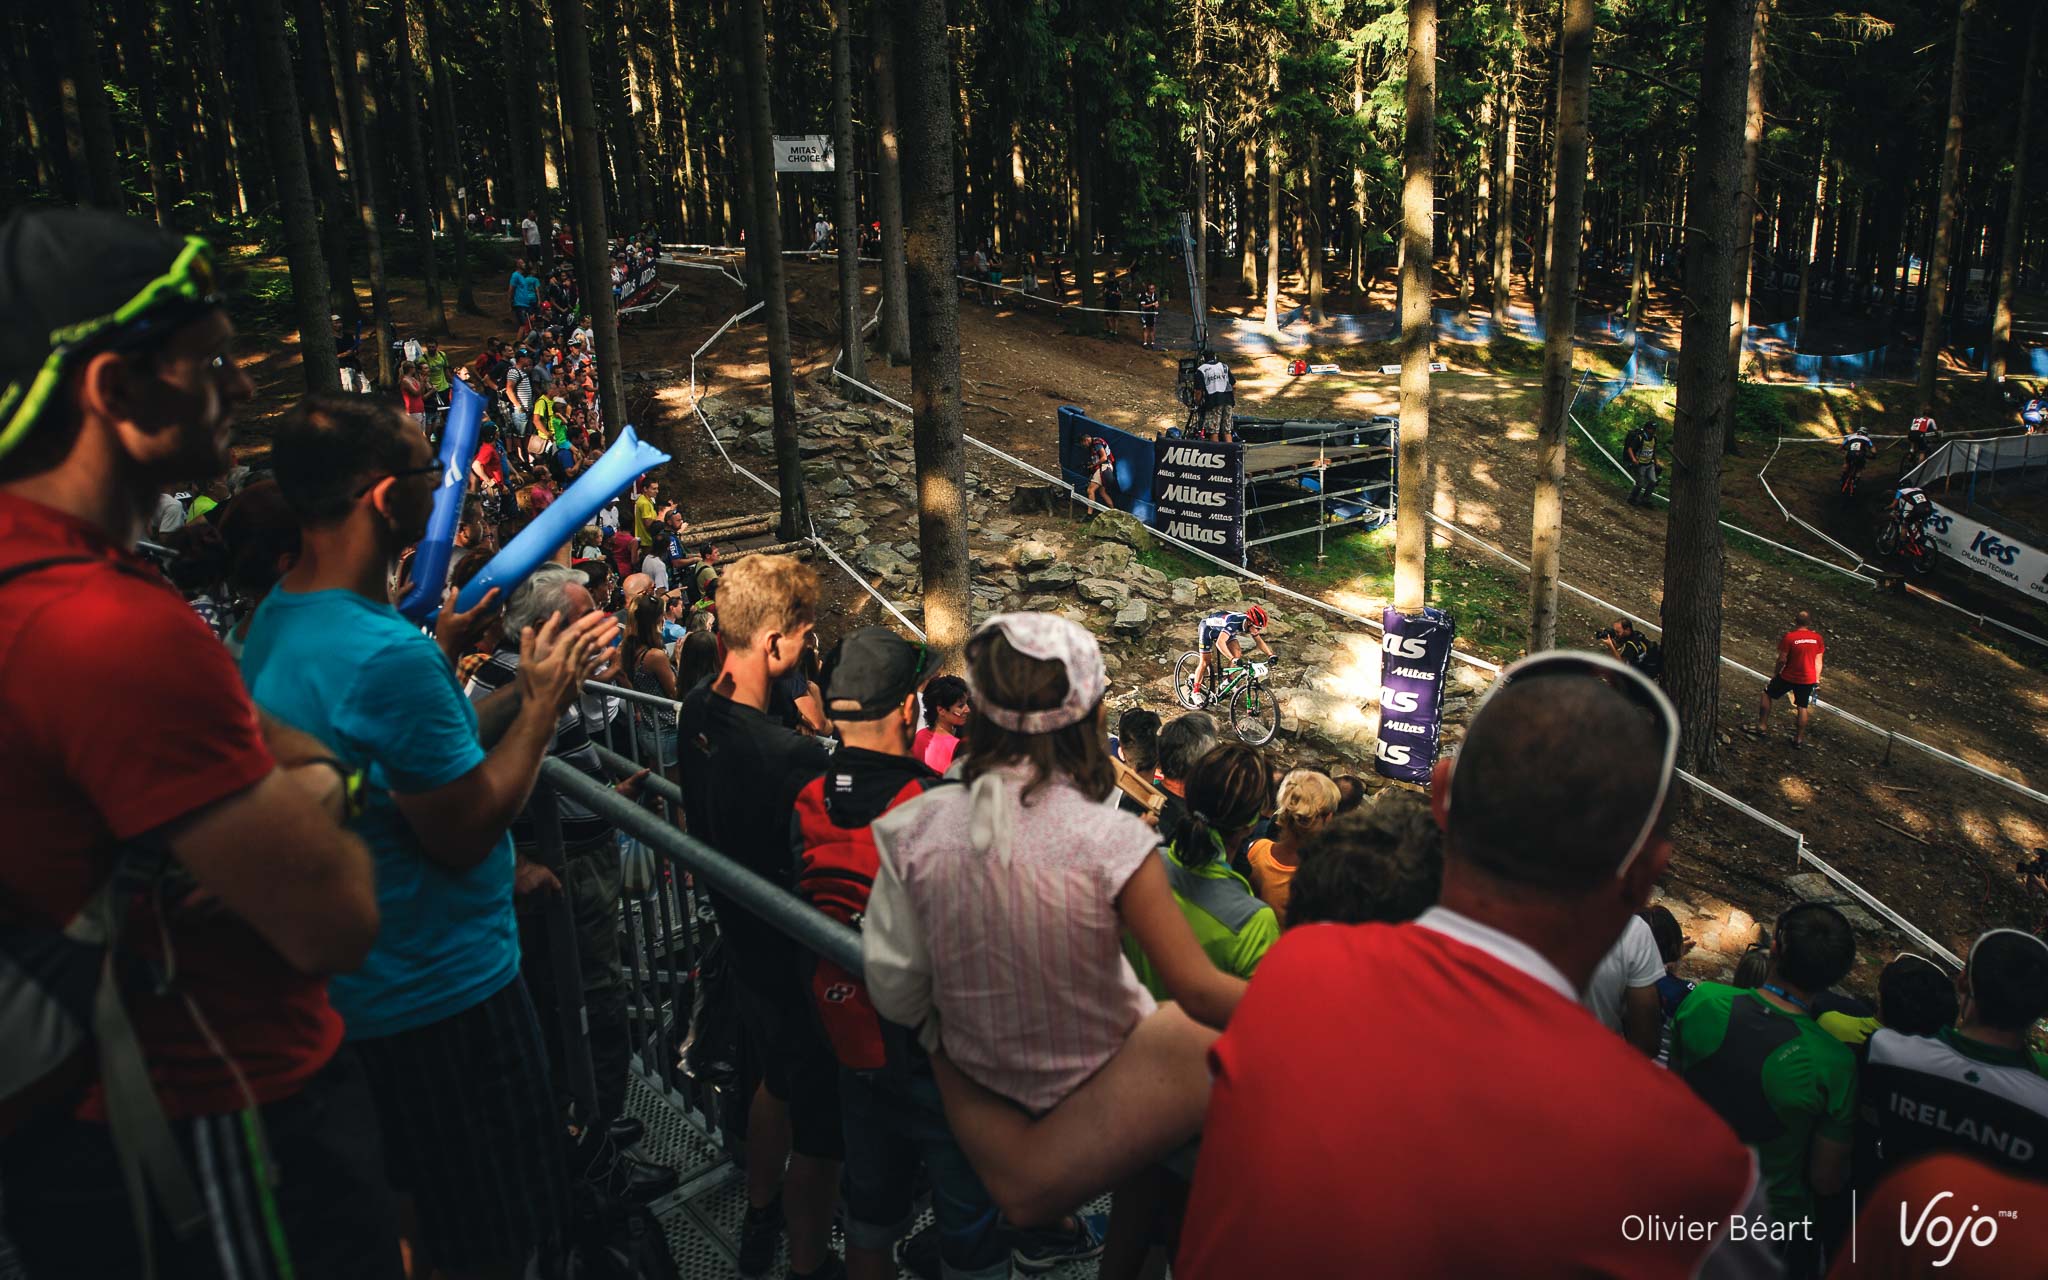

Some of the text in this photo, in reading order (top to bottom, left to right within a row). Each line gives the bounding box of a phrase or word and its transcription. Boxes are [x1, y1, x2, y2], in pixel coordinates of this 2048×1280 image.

[790, 146, 817, 154] MITAS
[787, 154, 821, 163] CHOICE
[1161, 446, 1226, 469] Mitas
[1157, 469, 1233, 484] Mitas Mitas Mitas
[1161, 484, 1226, 507] Mitas
[1157, 506, 1233, 521] Mitas Mitas Mitas
[1165, 520, 1226, 545] Mitas
[1391, 666, 1436, 681] Mitas
[1383, 719, 1426, 734] Mitas
[1889, 1092, 2036, 1161] IRELAND
